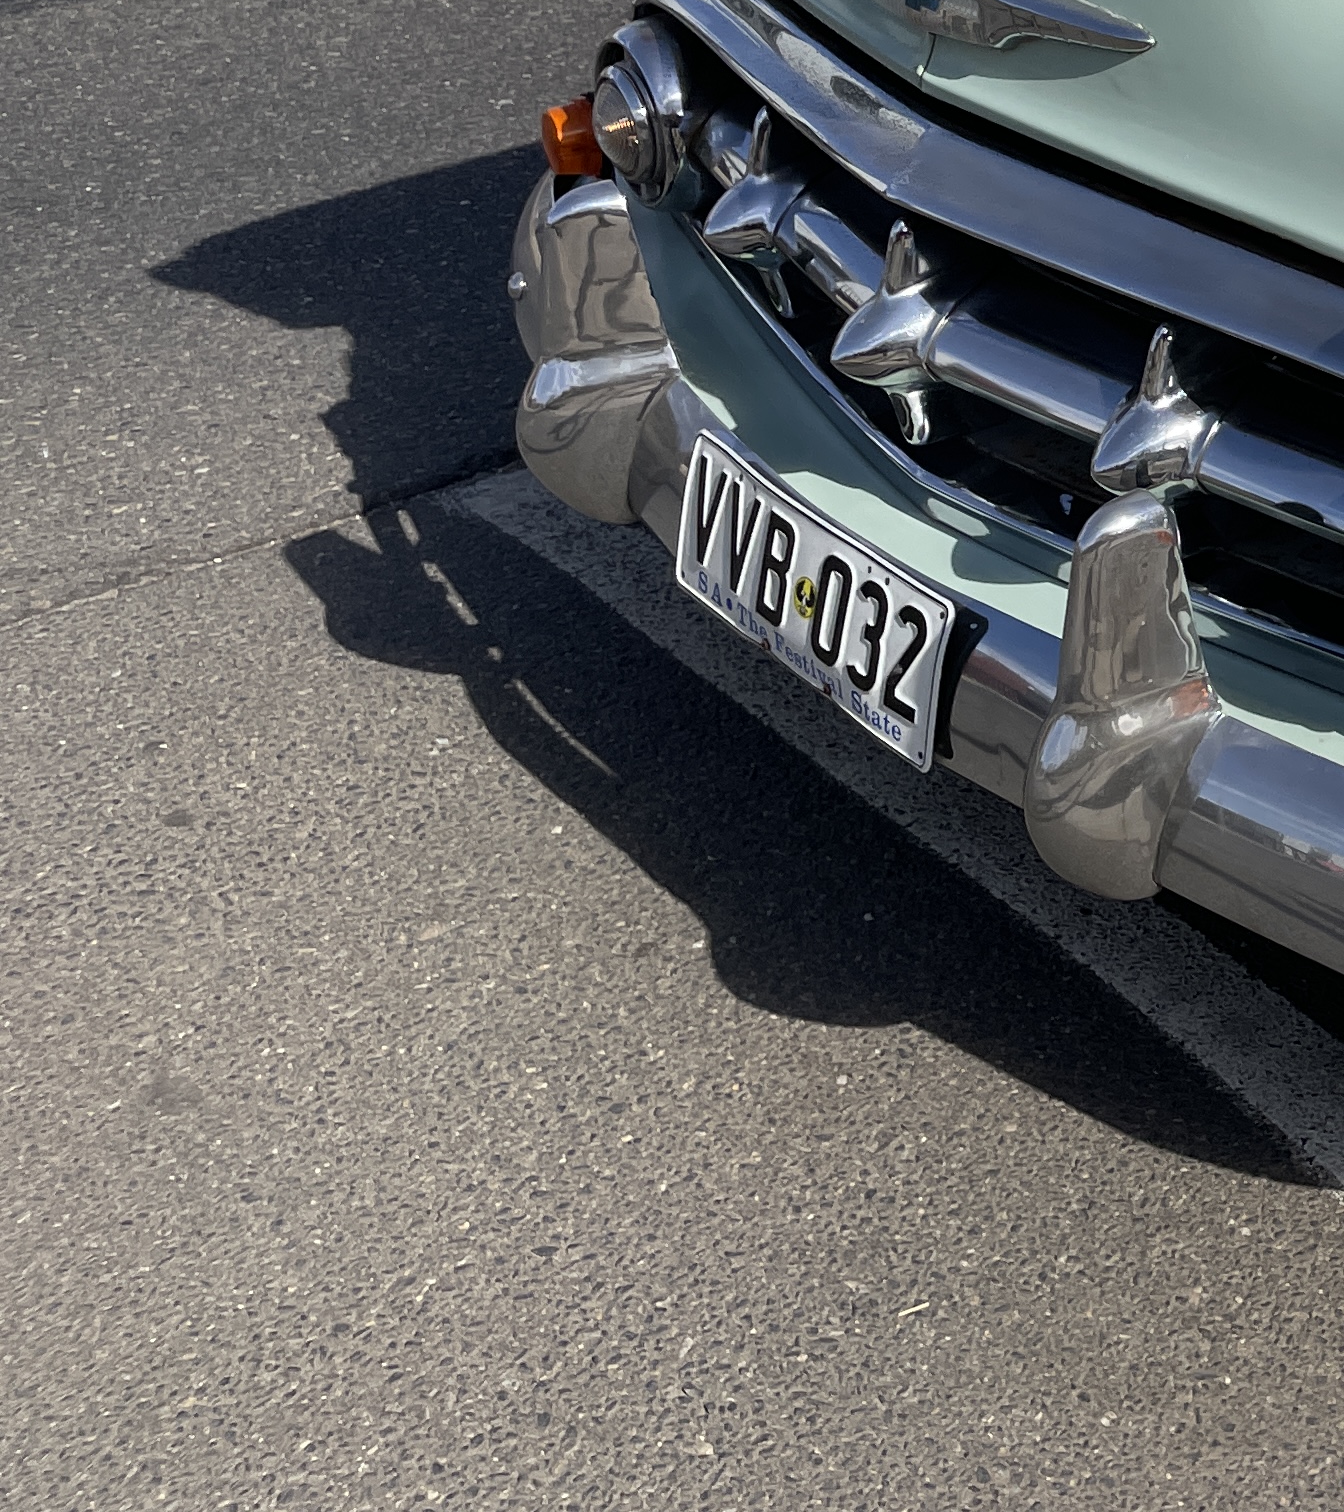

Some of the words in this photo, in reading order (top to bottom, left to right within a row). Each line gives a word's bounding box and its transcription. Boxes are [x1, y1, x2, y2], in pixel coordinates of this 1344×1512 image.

[696, 454, 797, 628] VVB
[811, 554, 929, 724] 032
[737, 604, 769, 640] The
[774, 631, 845, 700] Festival
[850, 689, 903, 743] State
